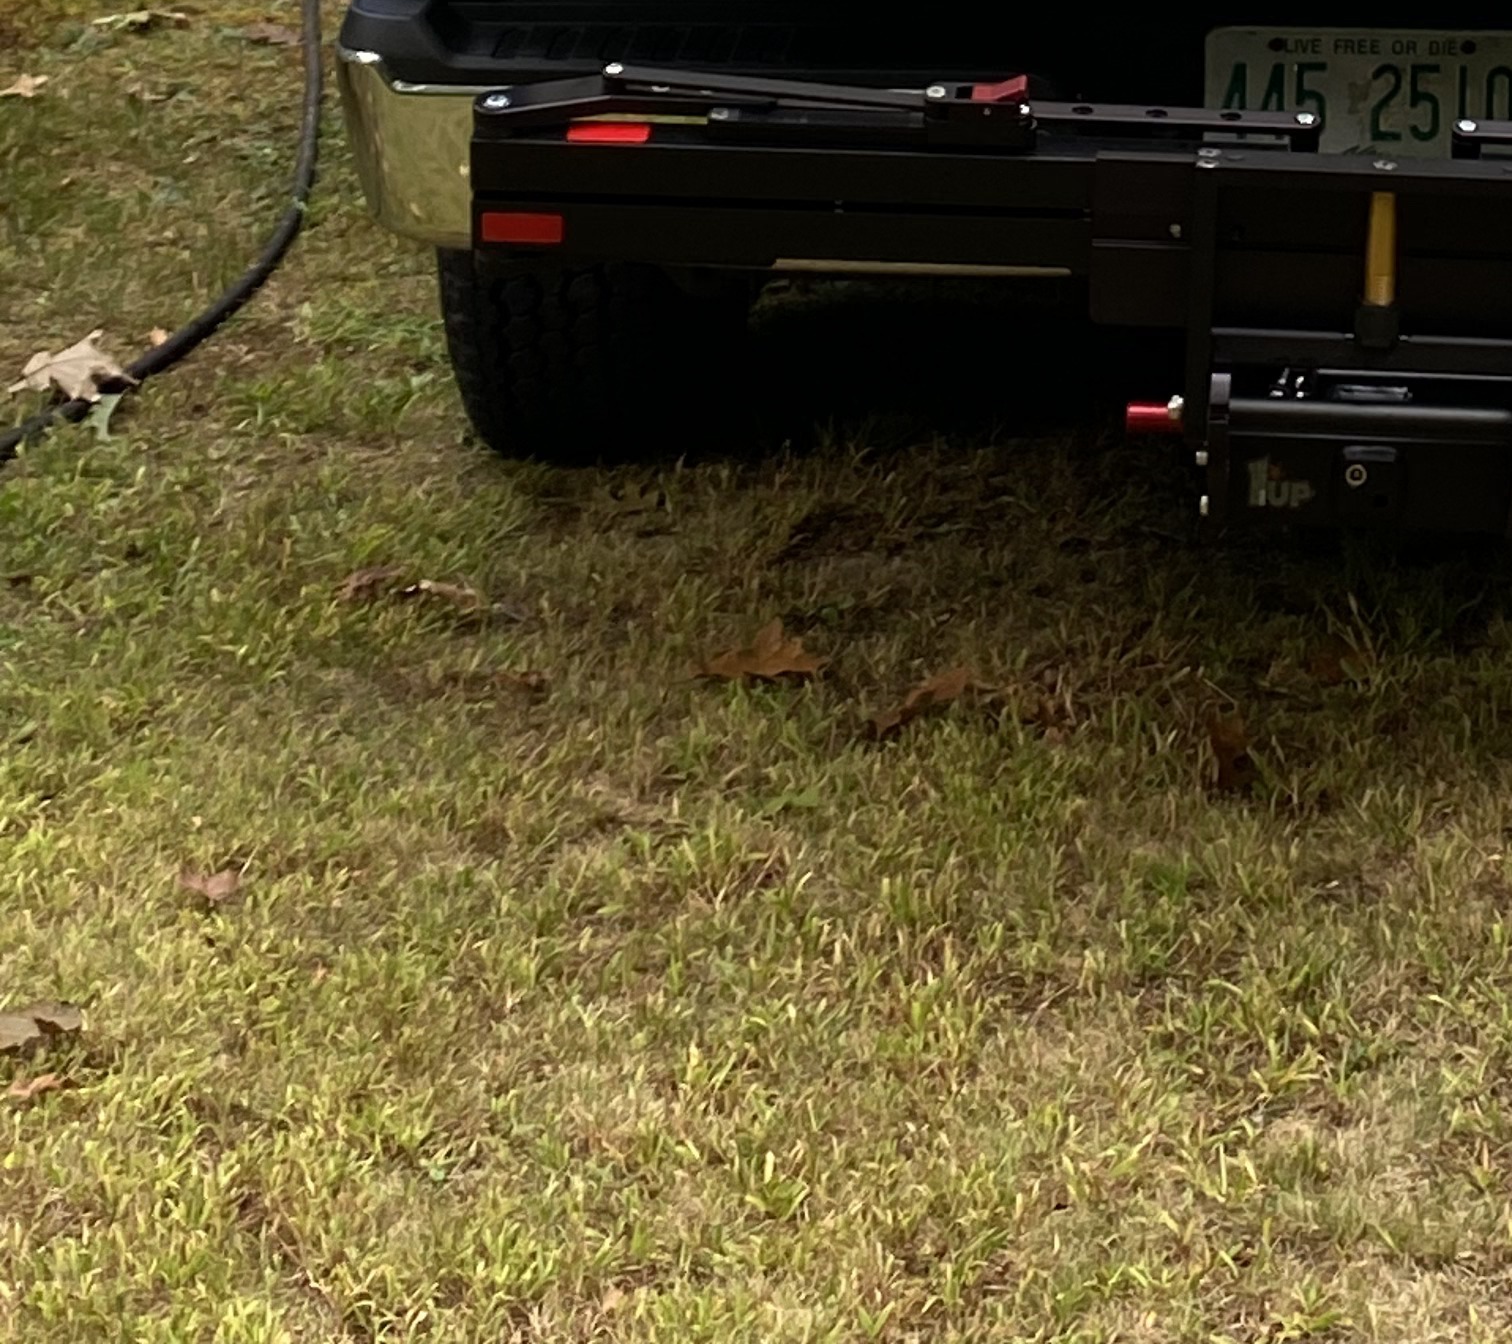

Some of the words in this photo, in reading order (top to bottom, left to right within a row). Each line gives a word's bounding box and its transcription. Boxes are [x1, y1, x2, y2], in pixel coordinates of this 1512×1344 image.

[1284, 38, 1322, 55] LIVE
[1333, 38, 1381, 55] FREE
[1391, 39, 1418, 56] OR
[1428, 39, 1459, 57] DIE
